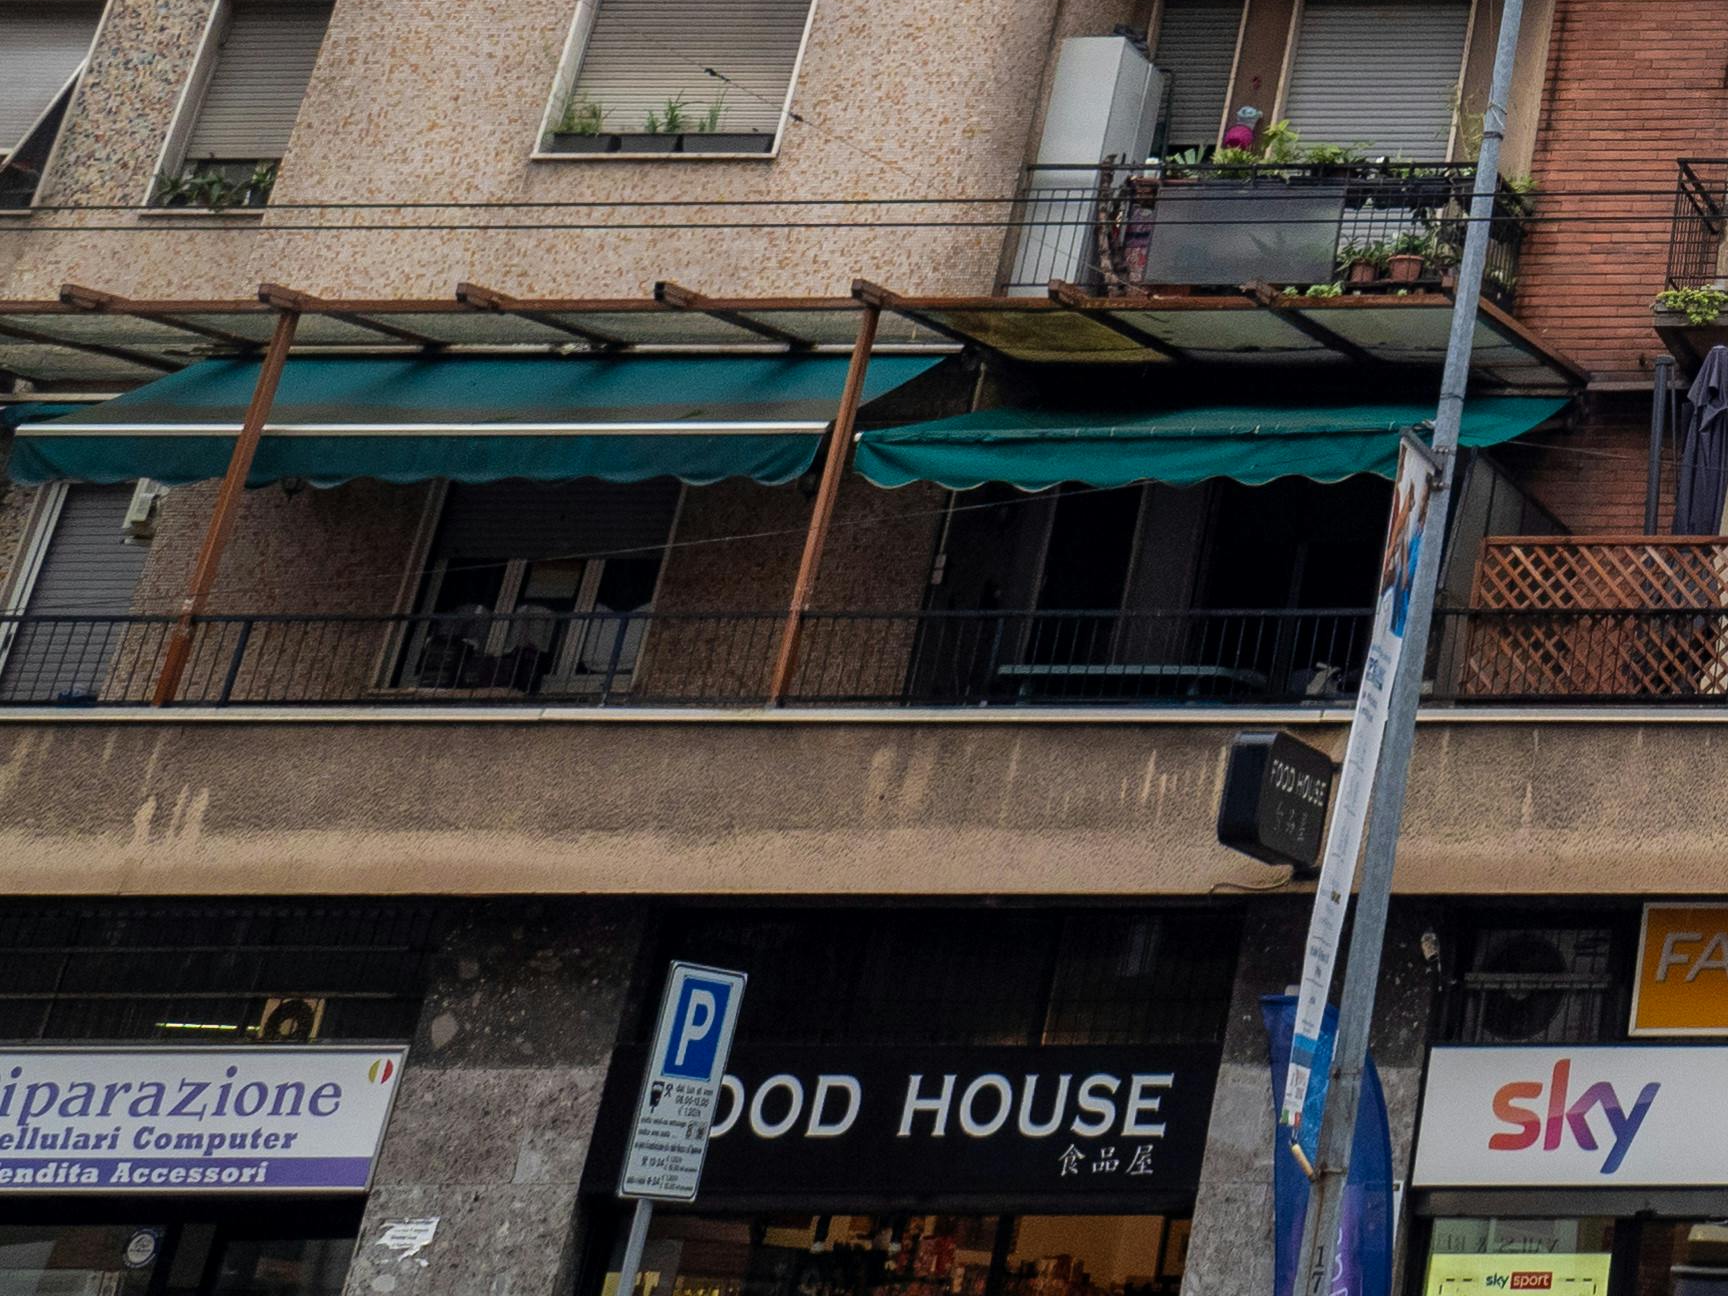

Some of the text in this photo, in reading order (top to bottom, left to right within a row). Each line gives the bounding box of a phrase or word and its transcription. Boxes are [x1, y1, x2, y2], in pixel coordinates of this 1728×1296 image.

[675, 989, 716, 1066] P
[0, 1066, 342, 1126] iparazione
[710, 1072, 1175, 1138] OOD HOUSE
[1489, 1059, 1661, 1174] sky
[0, 1126, 298, 1156] ellulari Computer
[1056, 1143, 1156, 1176] 食品屋
[0, 1160, 270, 1184] endita Accessori
[1485, 1272, 1550, 1289] sky sport
